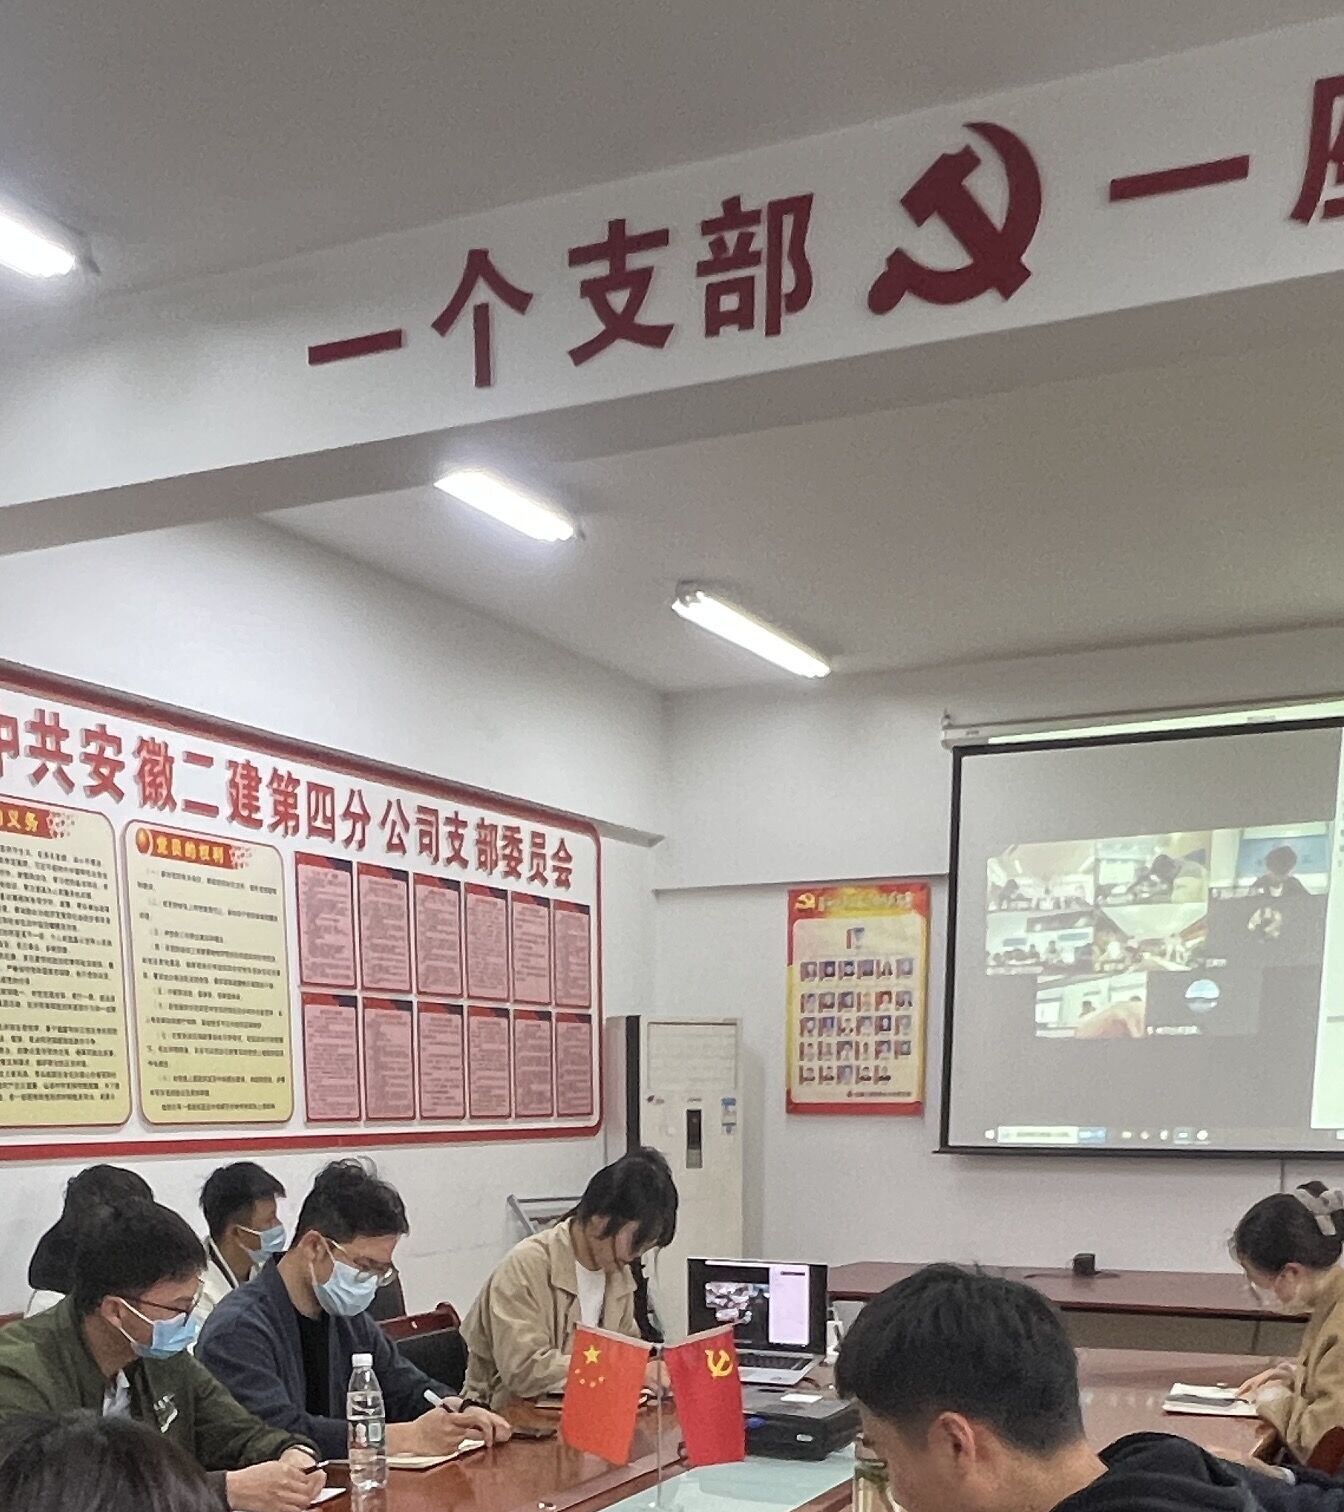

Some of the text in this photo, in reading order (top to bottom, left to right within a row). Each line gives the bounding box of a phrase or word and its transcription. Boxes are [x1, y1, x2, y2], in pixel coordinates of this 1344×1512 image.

[308, 192, 815, 389] 一个支部
[156, 835, 225, 864] 党员的权利
